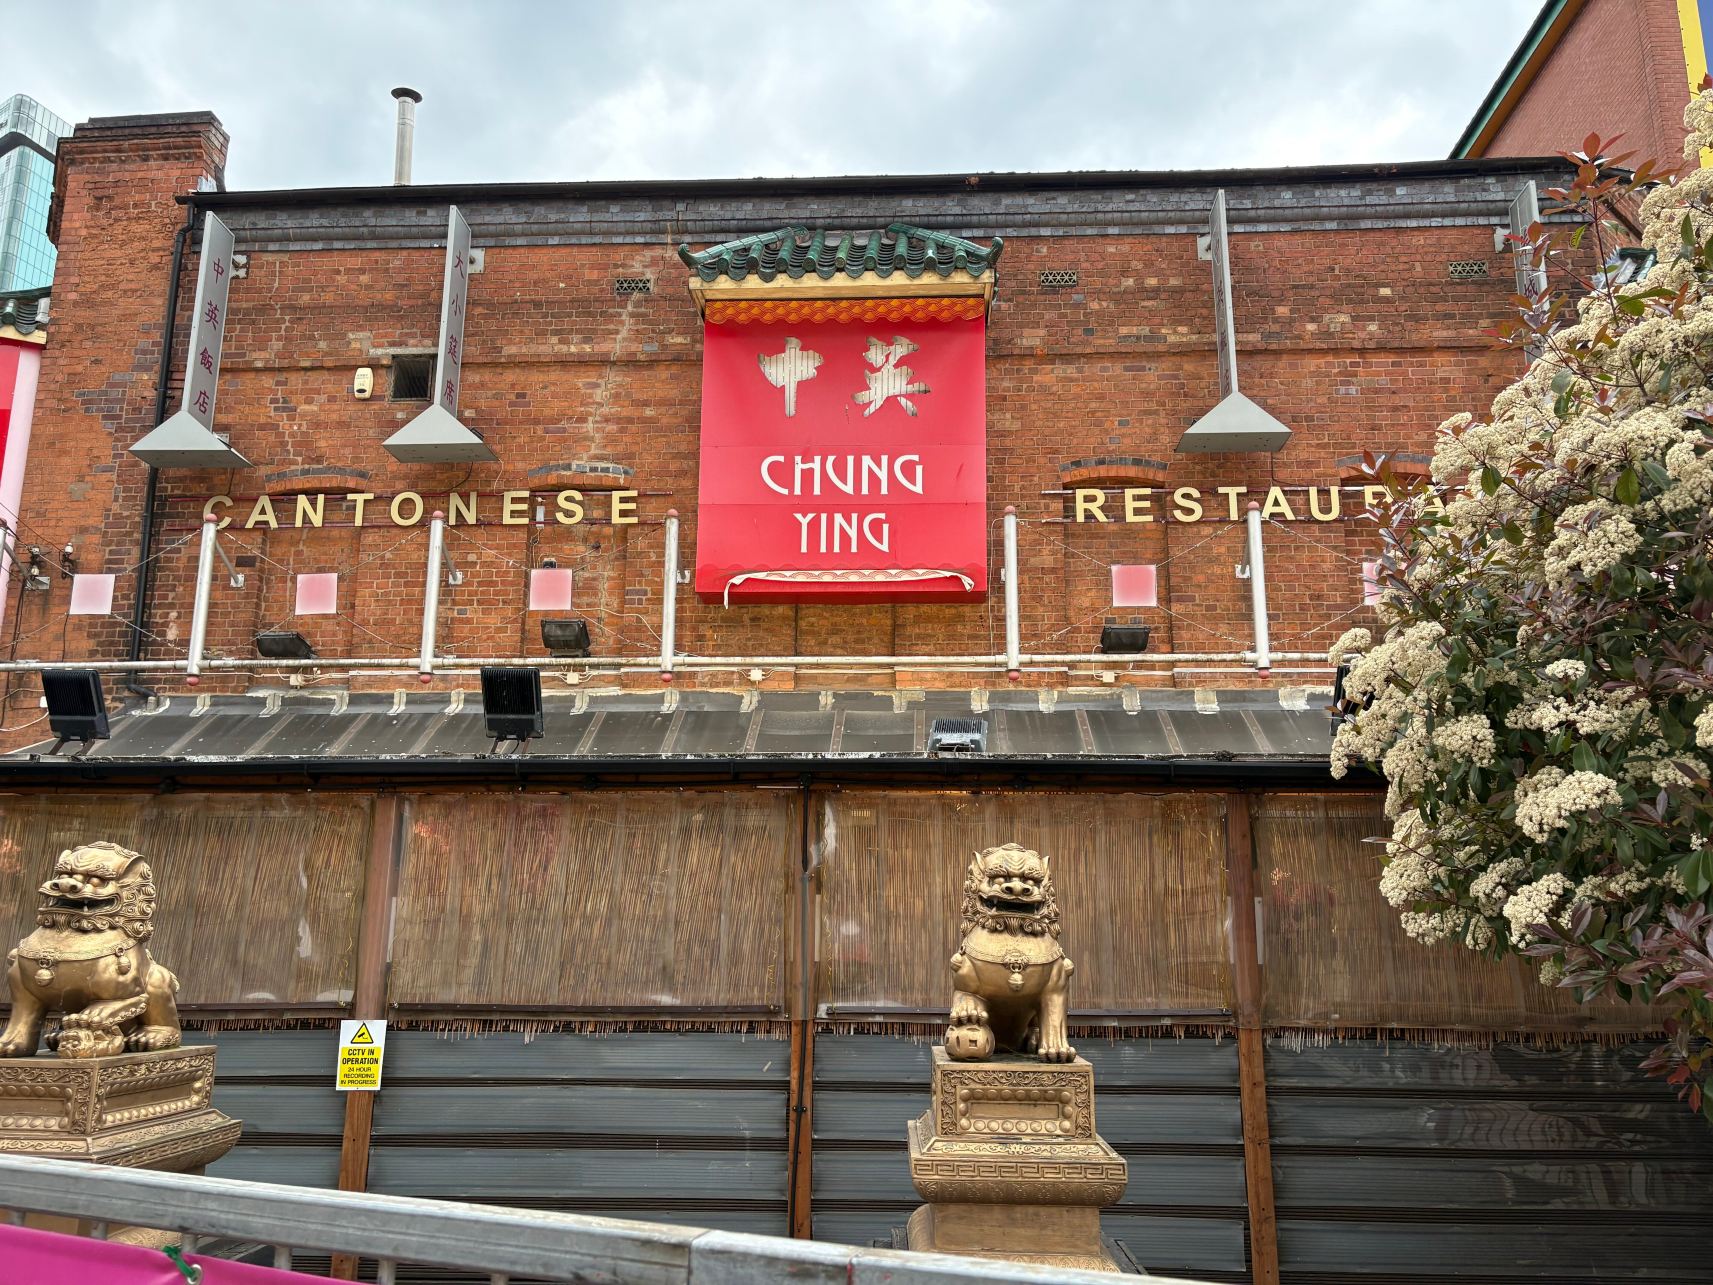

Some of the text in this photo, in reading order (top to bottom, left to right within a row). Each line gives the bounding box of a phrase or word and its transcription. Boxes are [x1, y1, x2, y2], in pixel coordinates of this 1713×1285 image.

[193, 257, 225, 416] 中英飯店
[757, 336, 931, 418] 中英
[760, 454, 924, 496] CHUNG
[203, 489, 638, 529] CANTONESE
[793, 512, 890, 553] YING
